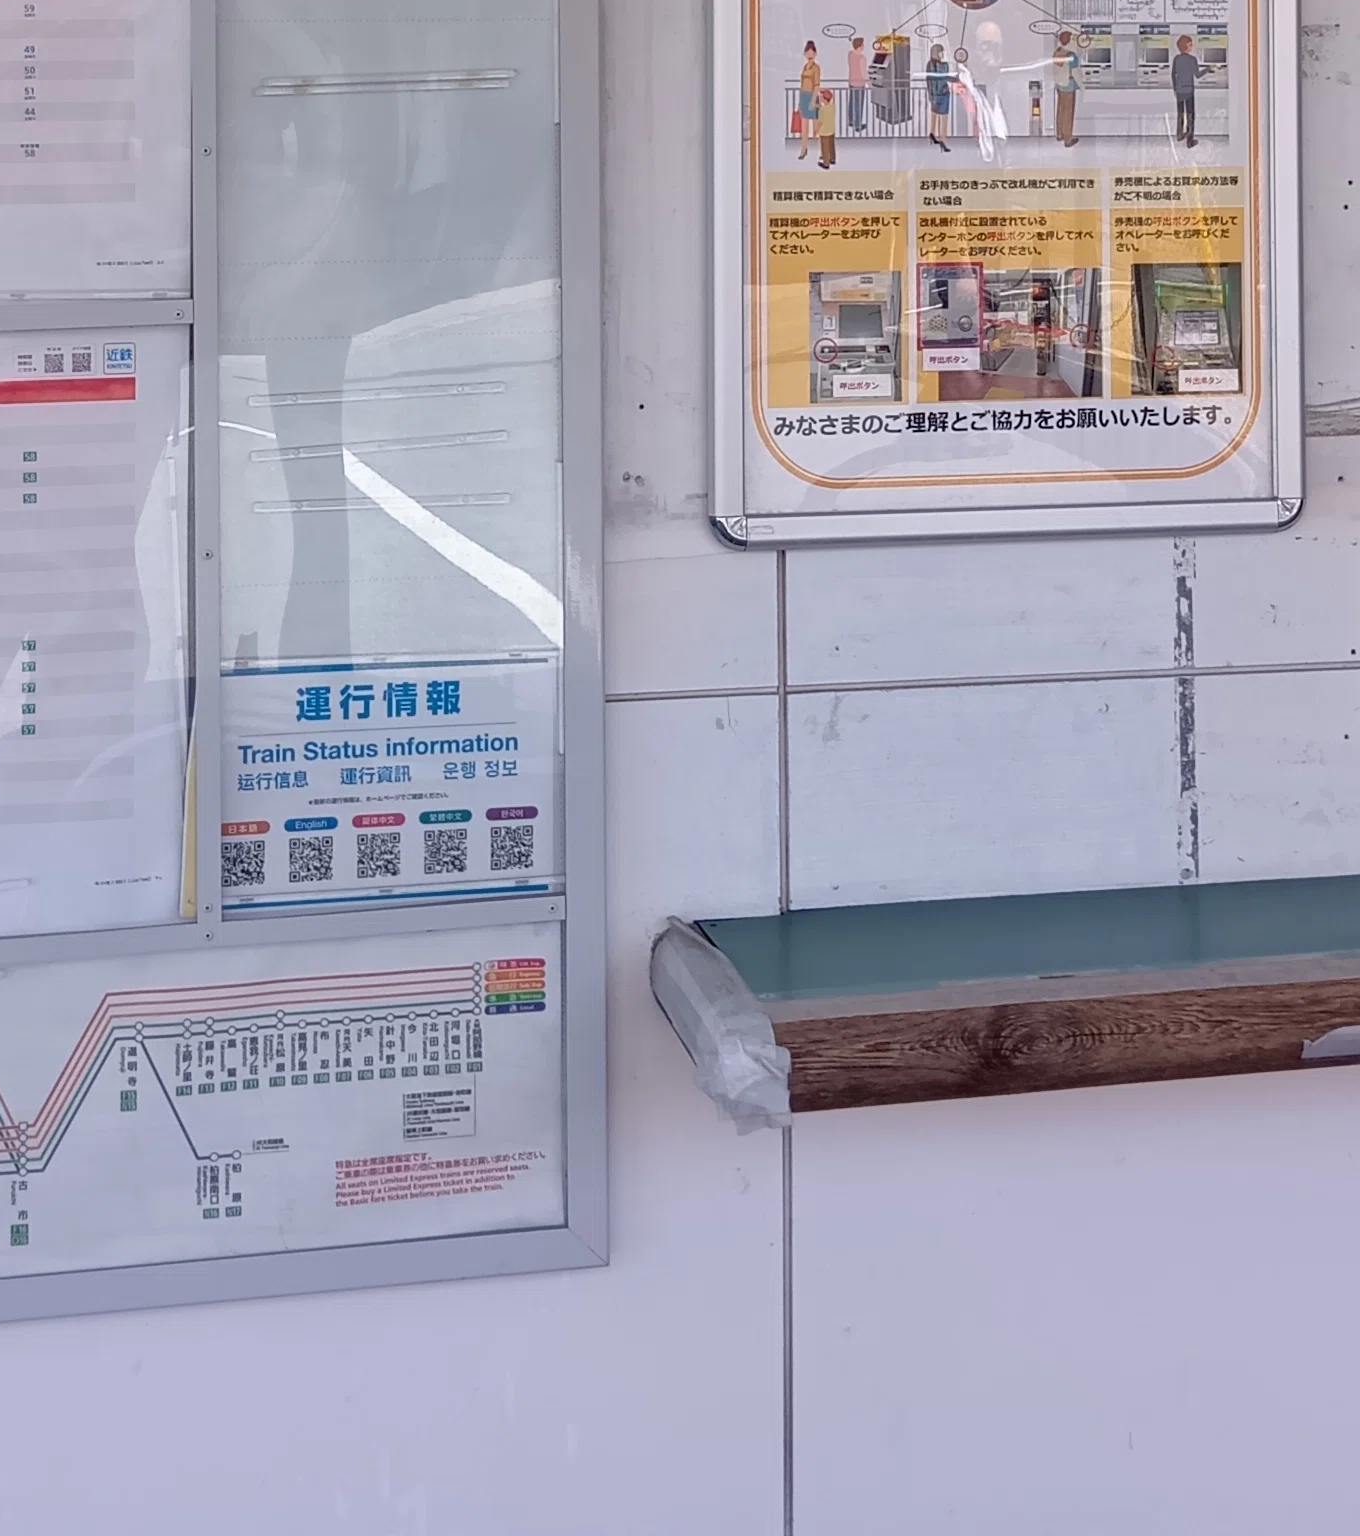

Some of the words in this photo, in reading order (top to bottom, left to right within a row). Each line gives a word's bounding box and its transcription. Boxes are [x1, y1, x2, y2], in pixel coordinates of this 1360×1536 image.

[920, 179, 1095, 190] お手持ちのきっぷで改札機がご利用でき
[773, 190, 895, 201] 精算機で精算できない場合
[923, 196, 962, 206] ない場合
[1114, 191, 1181, 201] がご不明の場合
[769, 216, 900, 228] 精算機の呼出ボタンを押して
[920, 216, 1047, 227] 改札機付近に設置されている
[1115, 216, 1238, 227] 券売機の呼出ボタンを押して
[770, 229, 881, 239] てオペレーターをお呼び
[918, 231, 1094, 242] インターホンの呼出ボタンを押してオペ
[1115, 229, 1230, 239] オペレーターをお呼びくだ
[770, 244, 814, 254] ください。
[920, 245, 1042, 256] レーターをお呼びください。
[1116, 242, 1140, 253] さい。
[105, 348, 133, 363] 近鉄
[929, 354, 968, 365] 呼出ボタン
[840, 380, 879, 391] 呼出ボタン
[773, 405, 1233, 437] みなさまのご理解とご協力をお願いいたします。
[295, 680, 462, 722] 運行情報
[238, 743, 296, 765] Train
[303, 738, 379, 762] Status
[386, 734, 519, 758] information
[340, 765, 412, 786] 運行資訊
[442, 761, 477, 782] 운행
[484, 759, 519, 778] 정보
[237, 770, 309, 792] 运行信息
[500, 808, 524, 819] 한국어
[228, 824, 258, 834] 日本語
[295, 819, 328, 831] English
